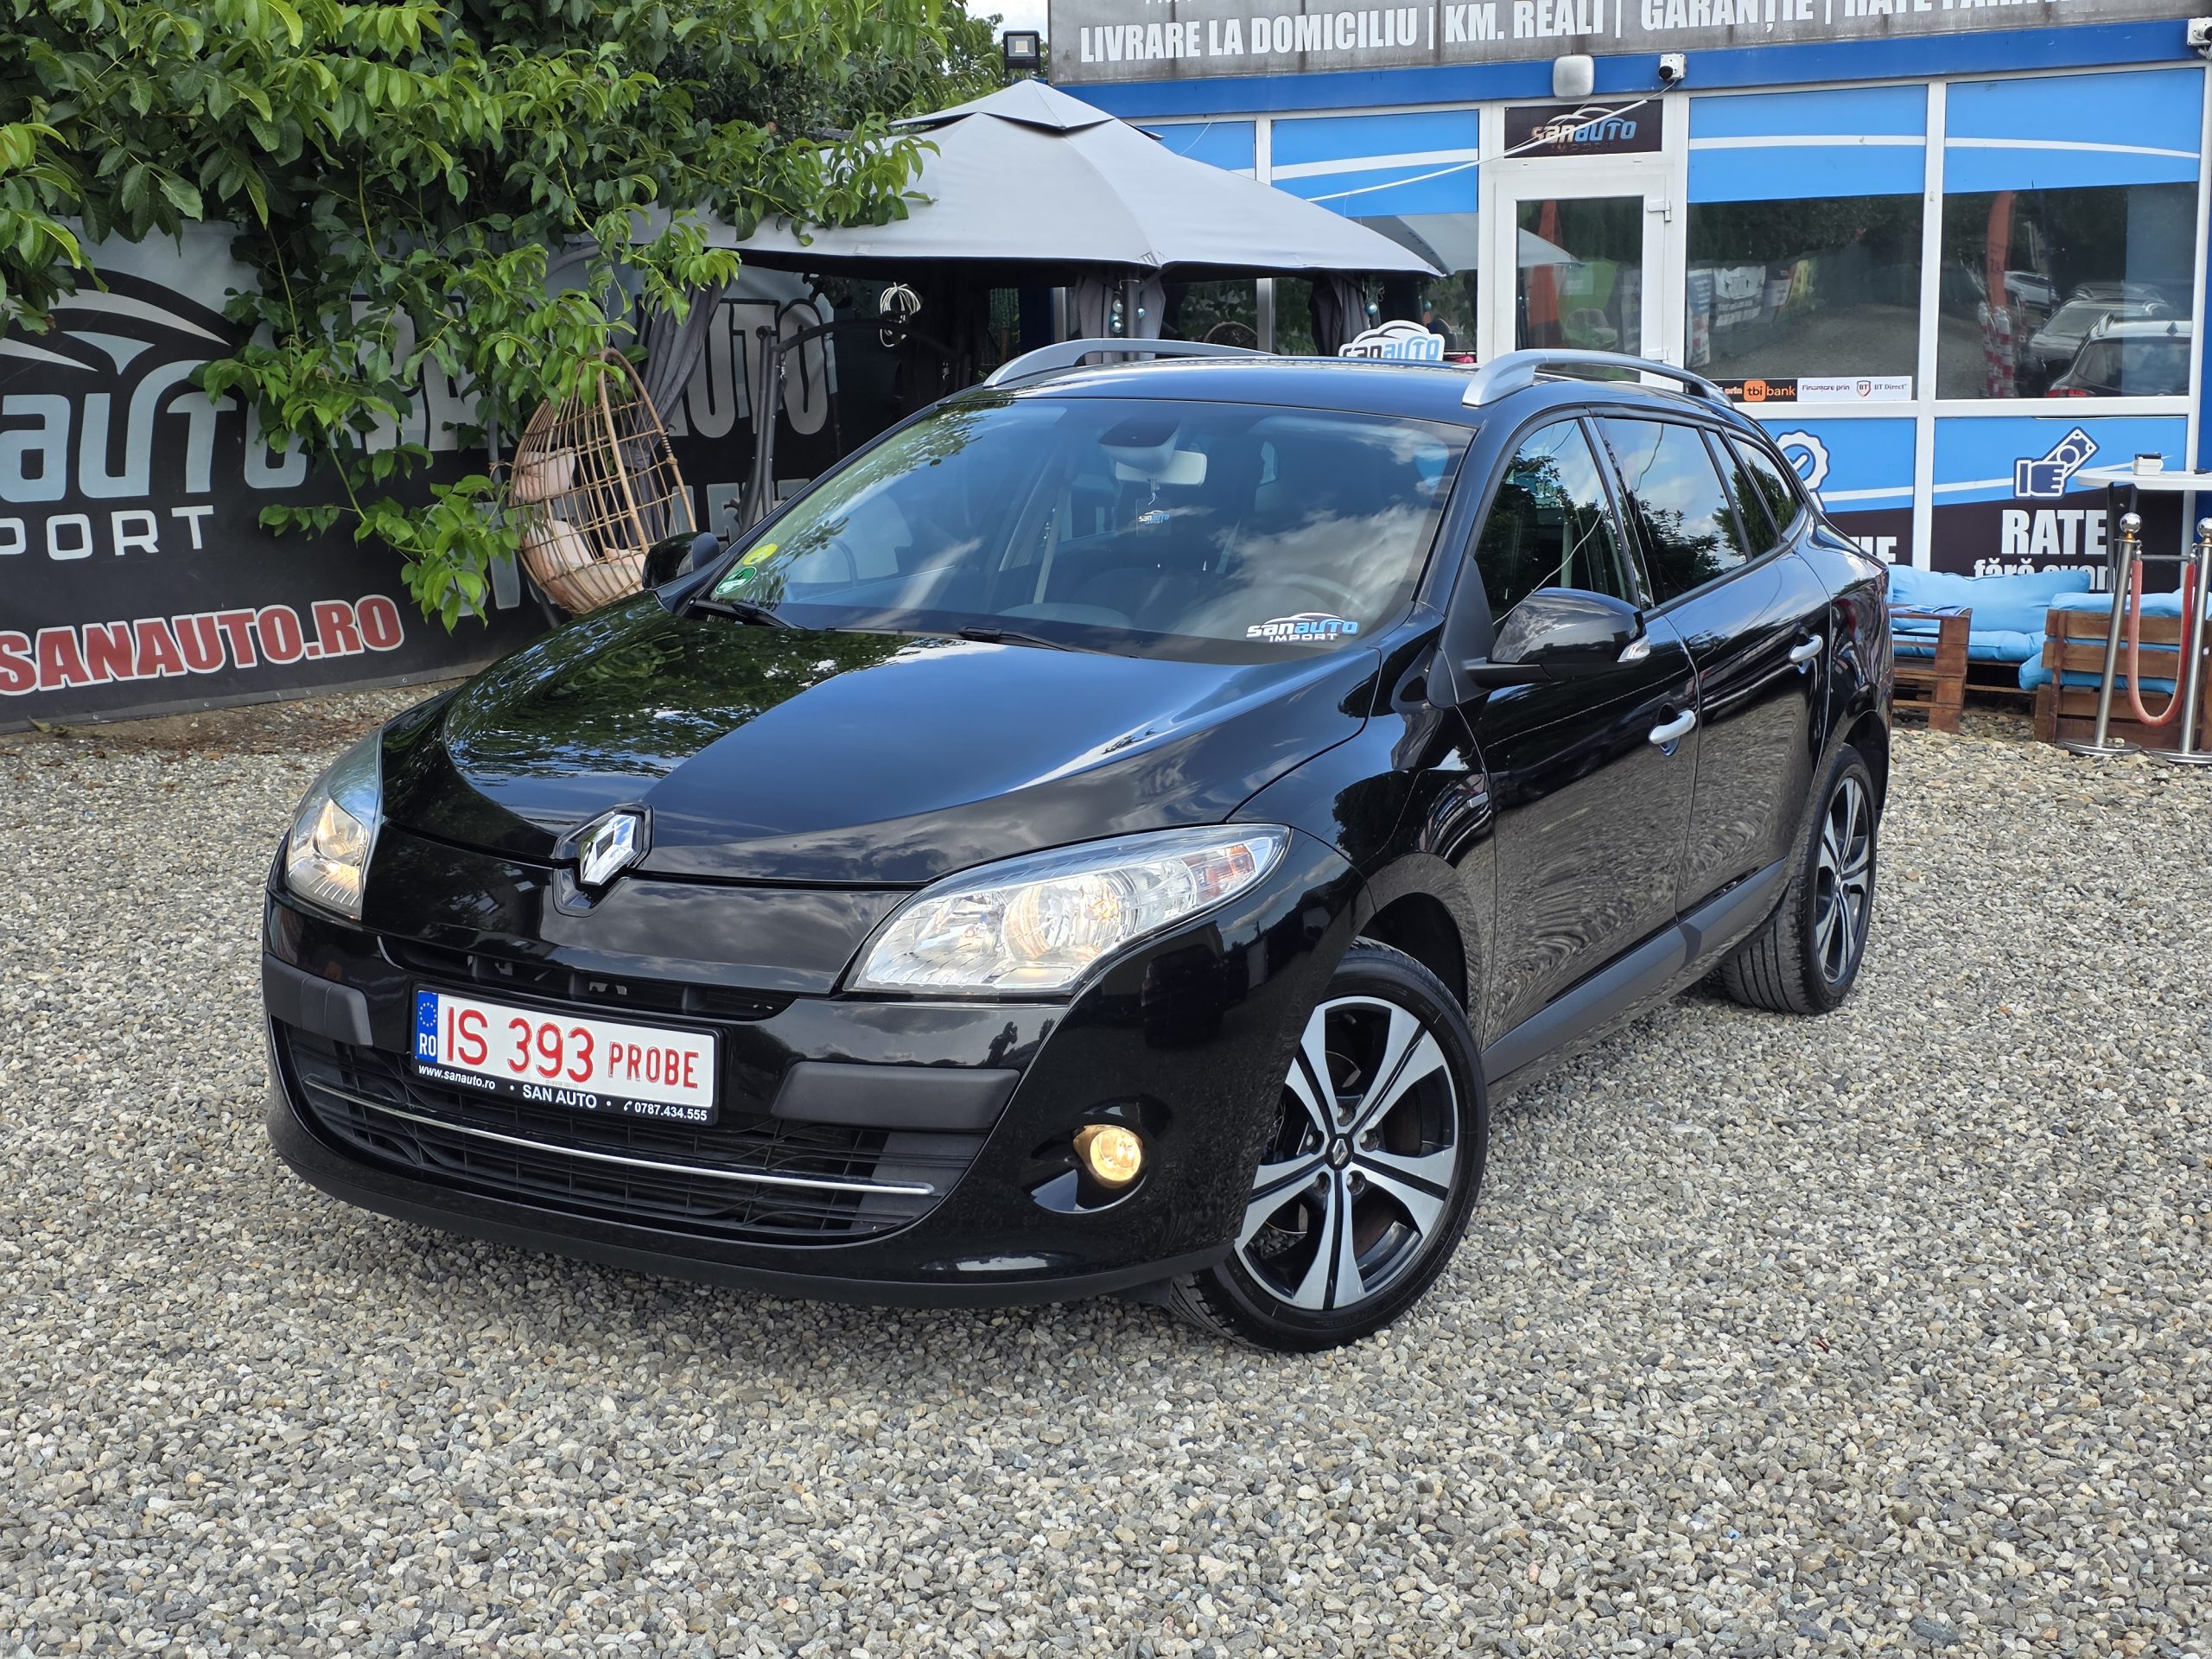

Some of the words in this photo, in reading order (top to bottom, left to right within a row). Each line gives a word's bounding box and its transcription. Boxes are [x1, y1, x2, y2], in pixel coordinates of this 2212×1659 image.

[1080, 21, 1201, 63] LIVRARE
[1209, 19, 1244, 56] LA
[1251, 7, 1417, 54] DOMICILIU
[1445, 3, 1505, 43] KM.
[1514, 0, 1604, 39] REALI
[1747, 385, 1763, 397] tbi
[1766, 385, 1796, 397] bank
[2001, 509, 2107, 555] RATE
[0, 594, 404, 696] SANAUTO.RO
[1269, 632, 1338, 643] IMPORT
[419, 1033, 437, 1058] RO
[446, 1005, 488, 1066] IS
[506, 1016, 595, 1084] 393
[607, 1039, 700, 1090] PROBE
[418, 1065, 496, 1090] www.sanauto.ro
[522, 1084, 553, 1103] SAN
[556, 1090, 597, 1109] AUTO
[634, 1101, 708, 1122] 0787.434.555
